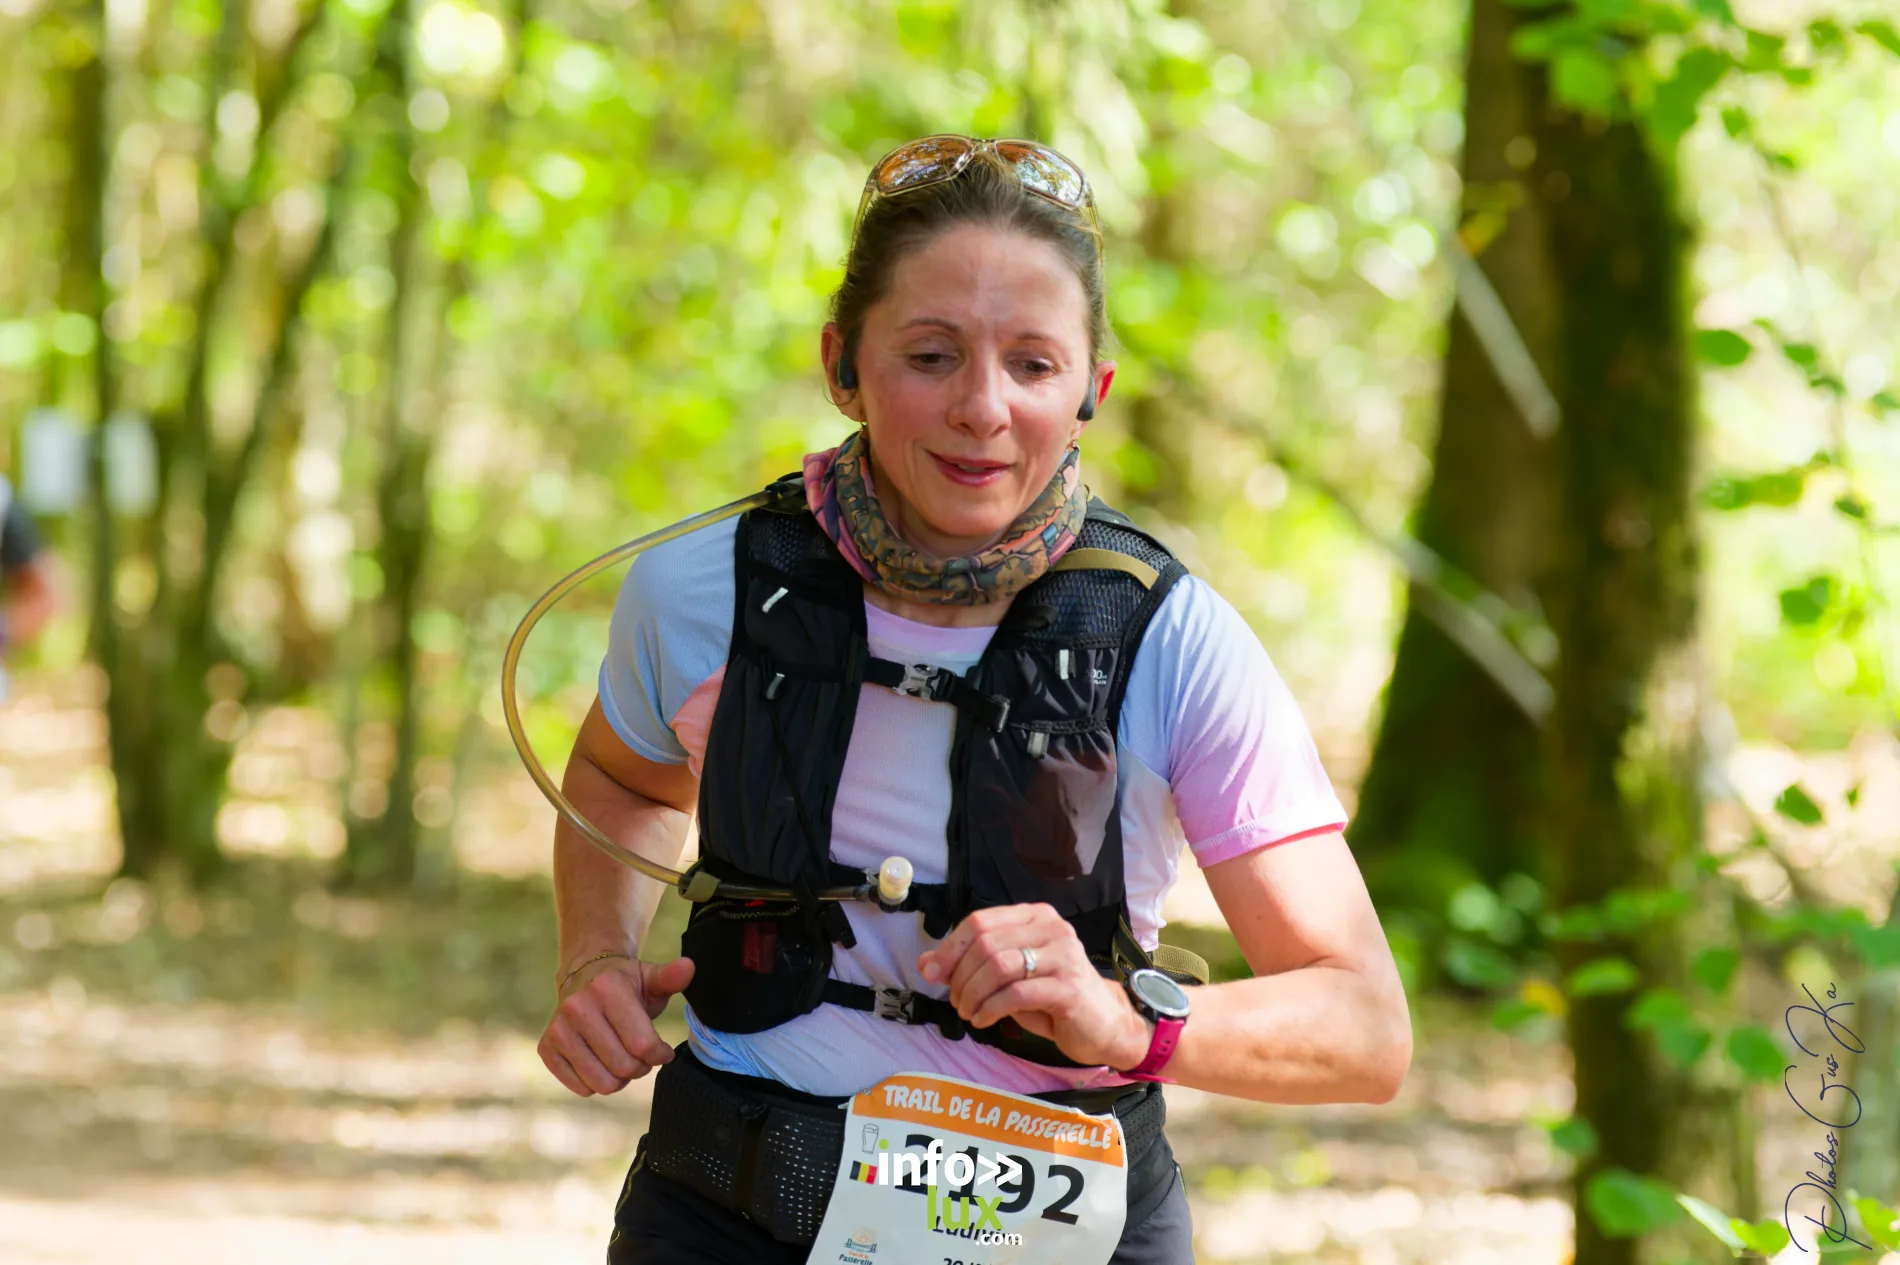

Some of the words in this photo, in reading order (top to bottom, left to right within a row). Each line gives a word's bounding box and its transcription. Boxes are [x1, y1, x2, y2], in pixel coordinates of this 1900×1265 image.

[884, 1084, 944, 1114] TRAIL
[948, 1096, 973, 1120] DE
[975, 1102, 1001, 1128] LA
[1003, 1111, 1113, 1150] PASSERELLE
